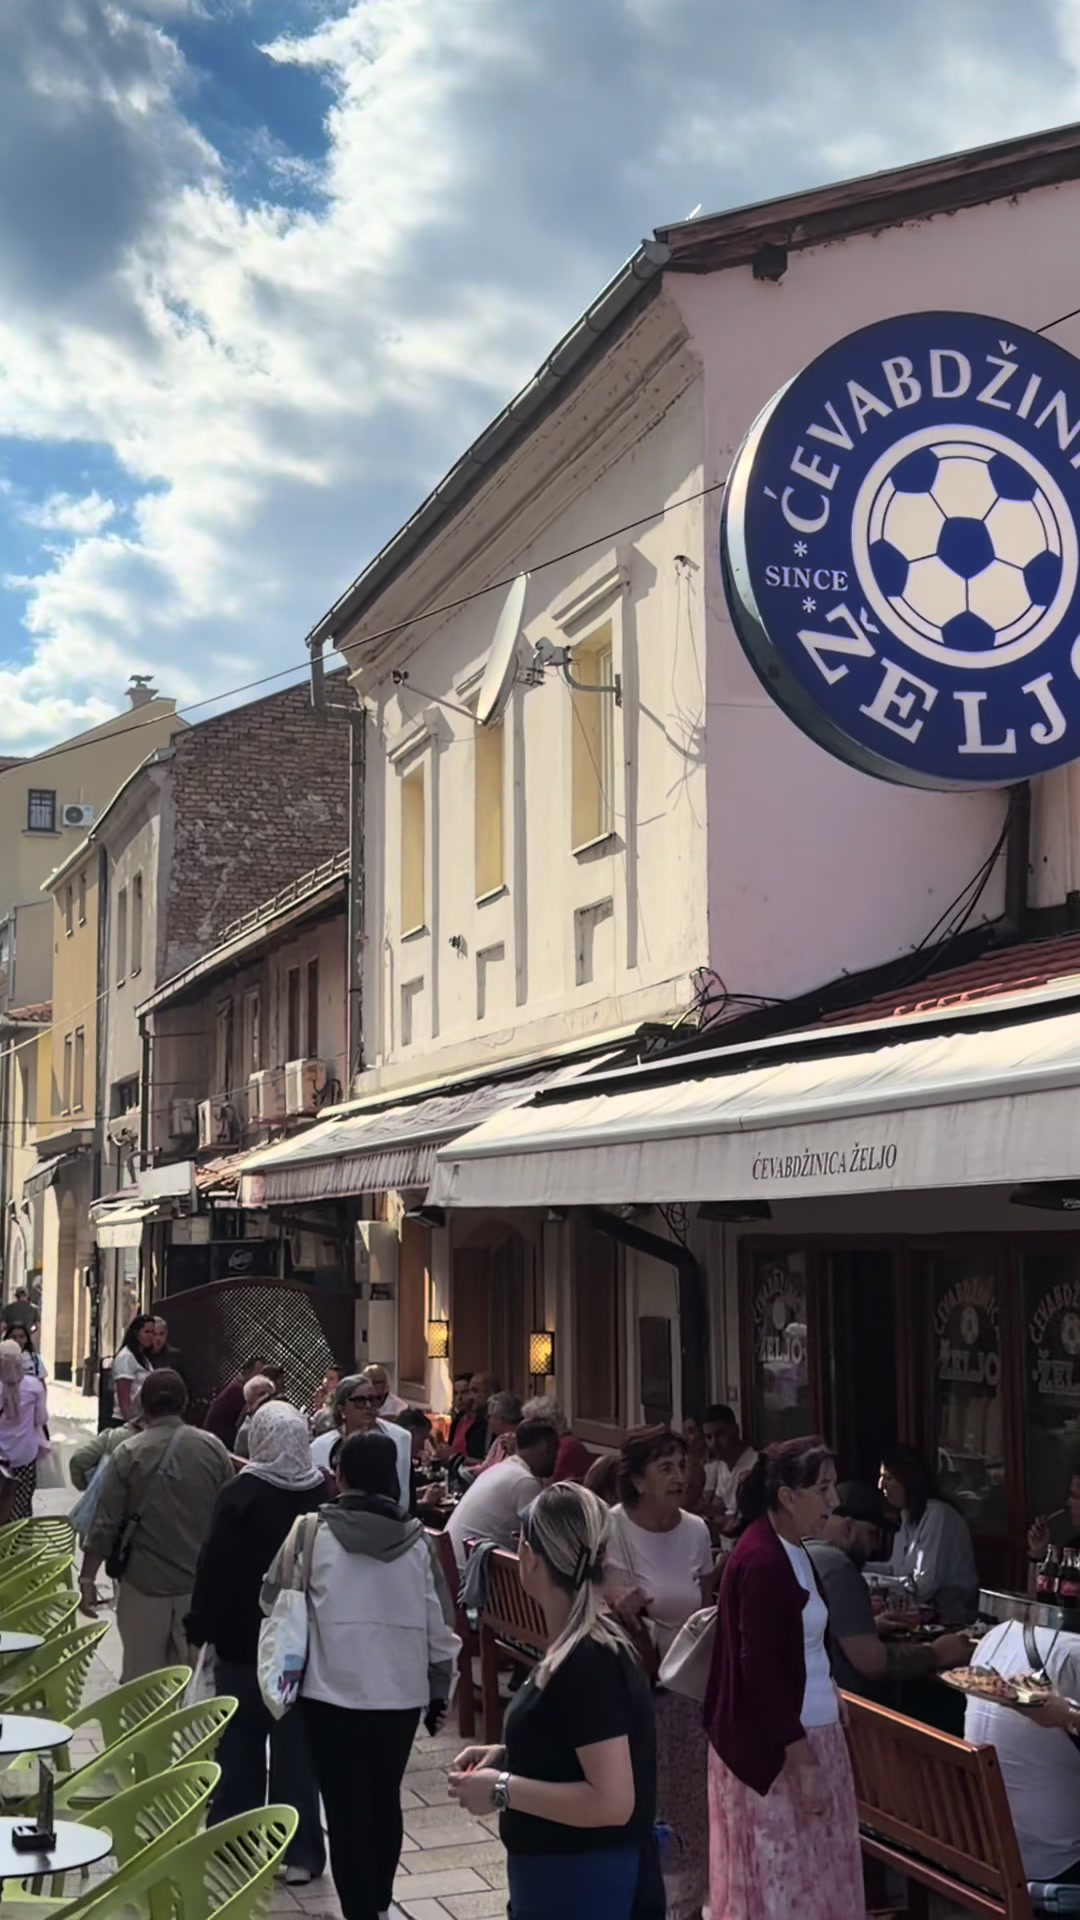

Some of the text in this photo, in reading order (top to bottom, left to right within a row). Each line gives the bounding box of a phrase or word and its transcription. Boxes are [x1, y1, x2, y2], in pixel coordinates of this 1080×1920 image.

[763, 340, 1080, 534] ĆEVABDŽIN
[765, 565, 849, 592] SINCE
[797, 602, 1080, 754] ŽELJ
[752, 1142, 898, 1180] ĆEVABDŽINICA ŽELJO
